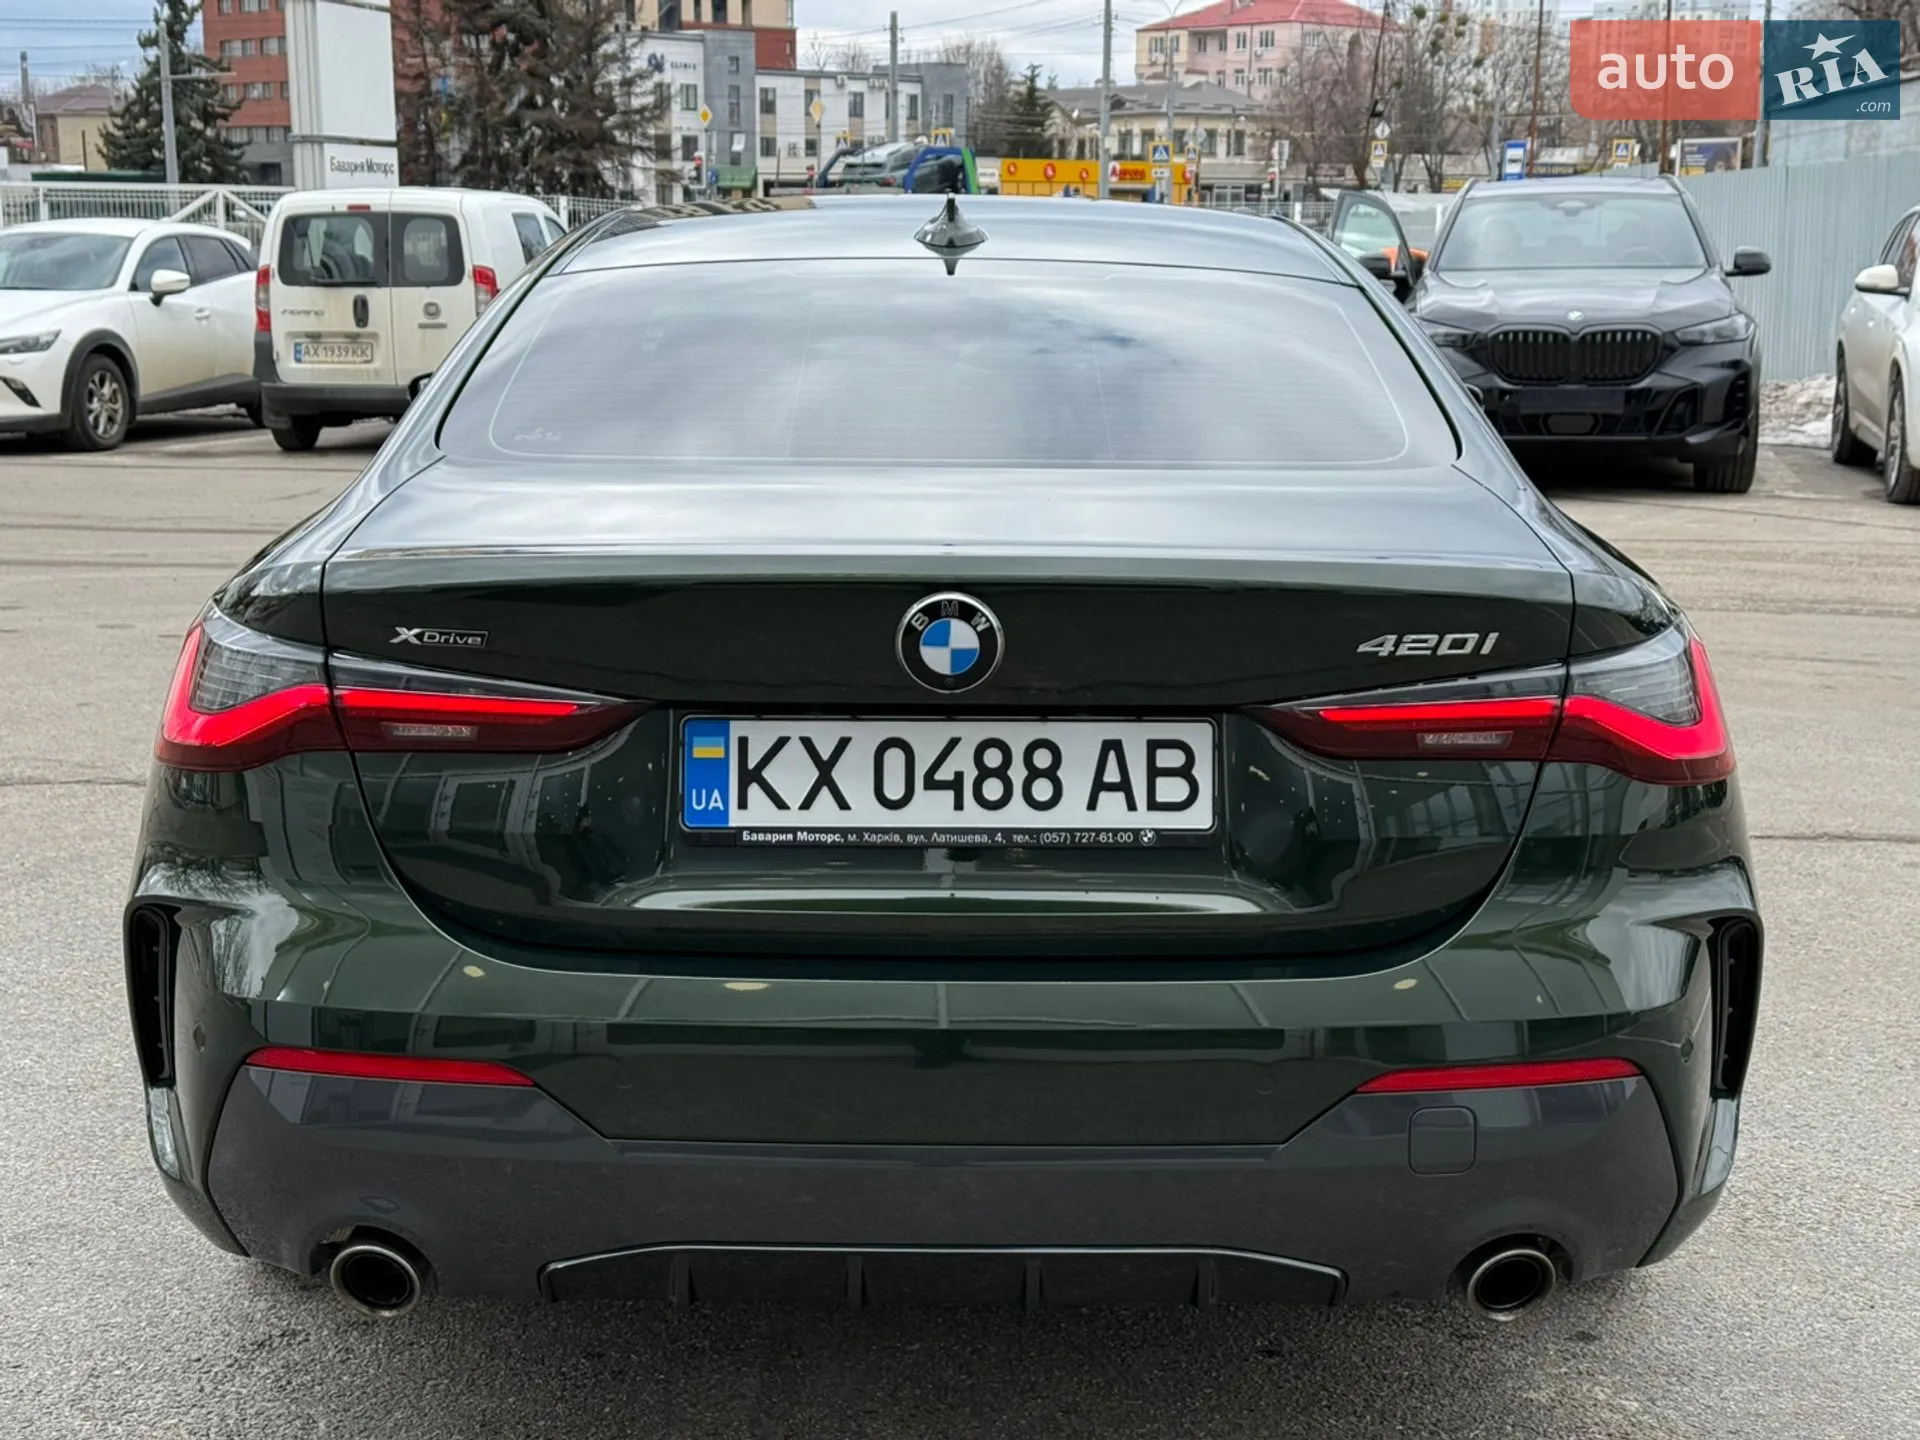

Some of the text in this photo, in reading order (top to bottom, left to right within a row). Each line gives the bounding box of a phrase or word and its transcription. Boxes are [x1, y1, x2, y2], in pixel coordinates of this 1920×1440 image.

[351, 345, 369, 358] KK
[911, 600, 991, 632] BMW
[736, 736, 1200, 812] KX 0488 AB
[691, 788, 725, 811] UA
[742, 831, 793, 843] Бавария
[796, 831, 845, 843] Моторс,
[994, 832, 1006, 844] 4,
[1039, 832, 1071, 845] (057)
[1074, 832, 1134, 843] 727-61-00
